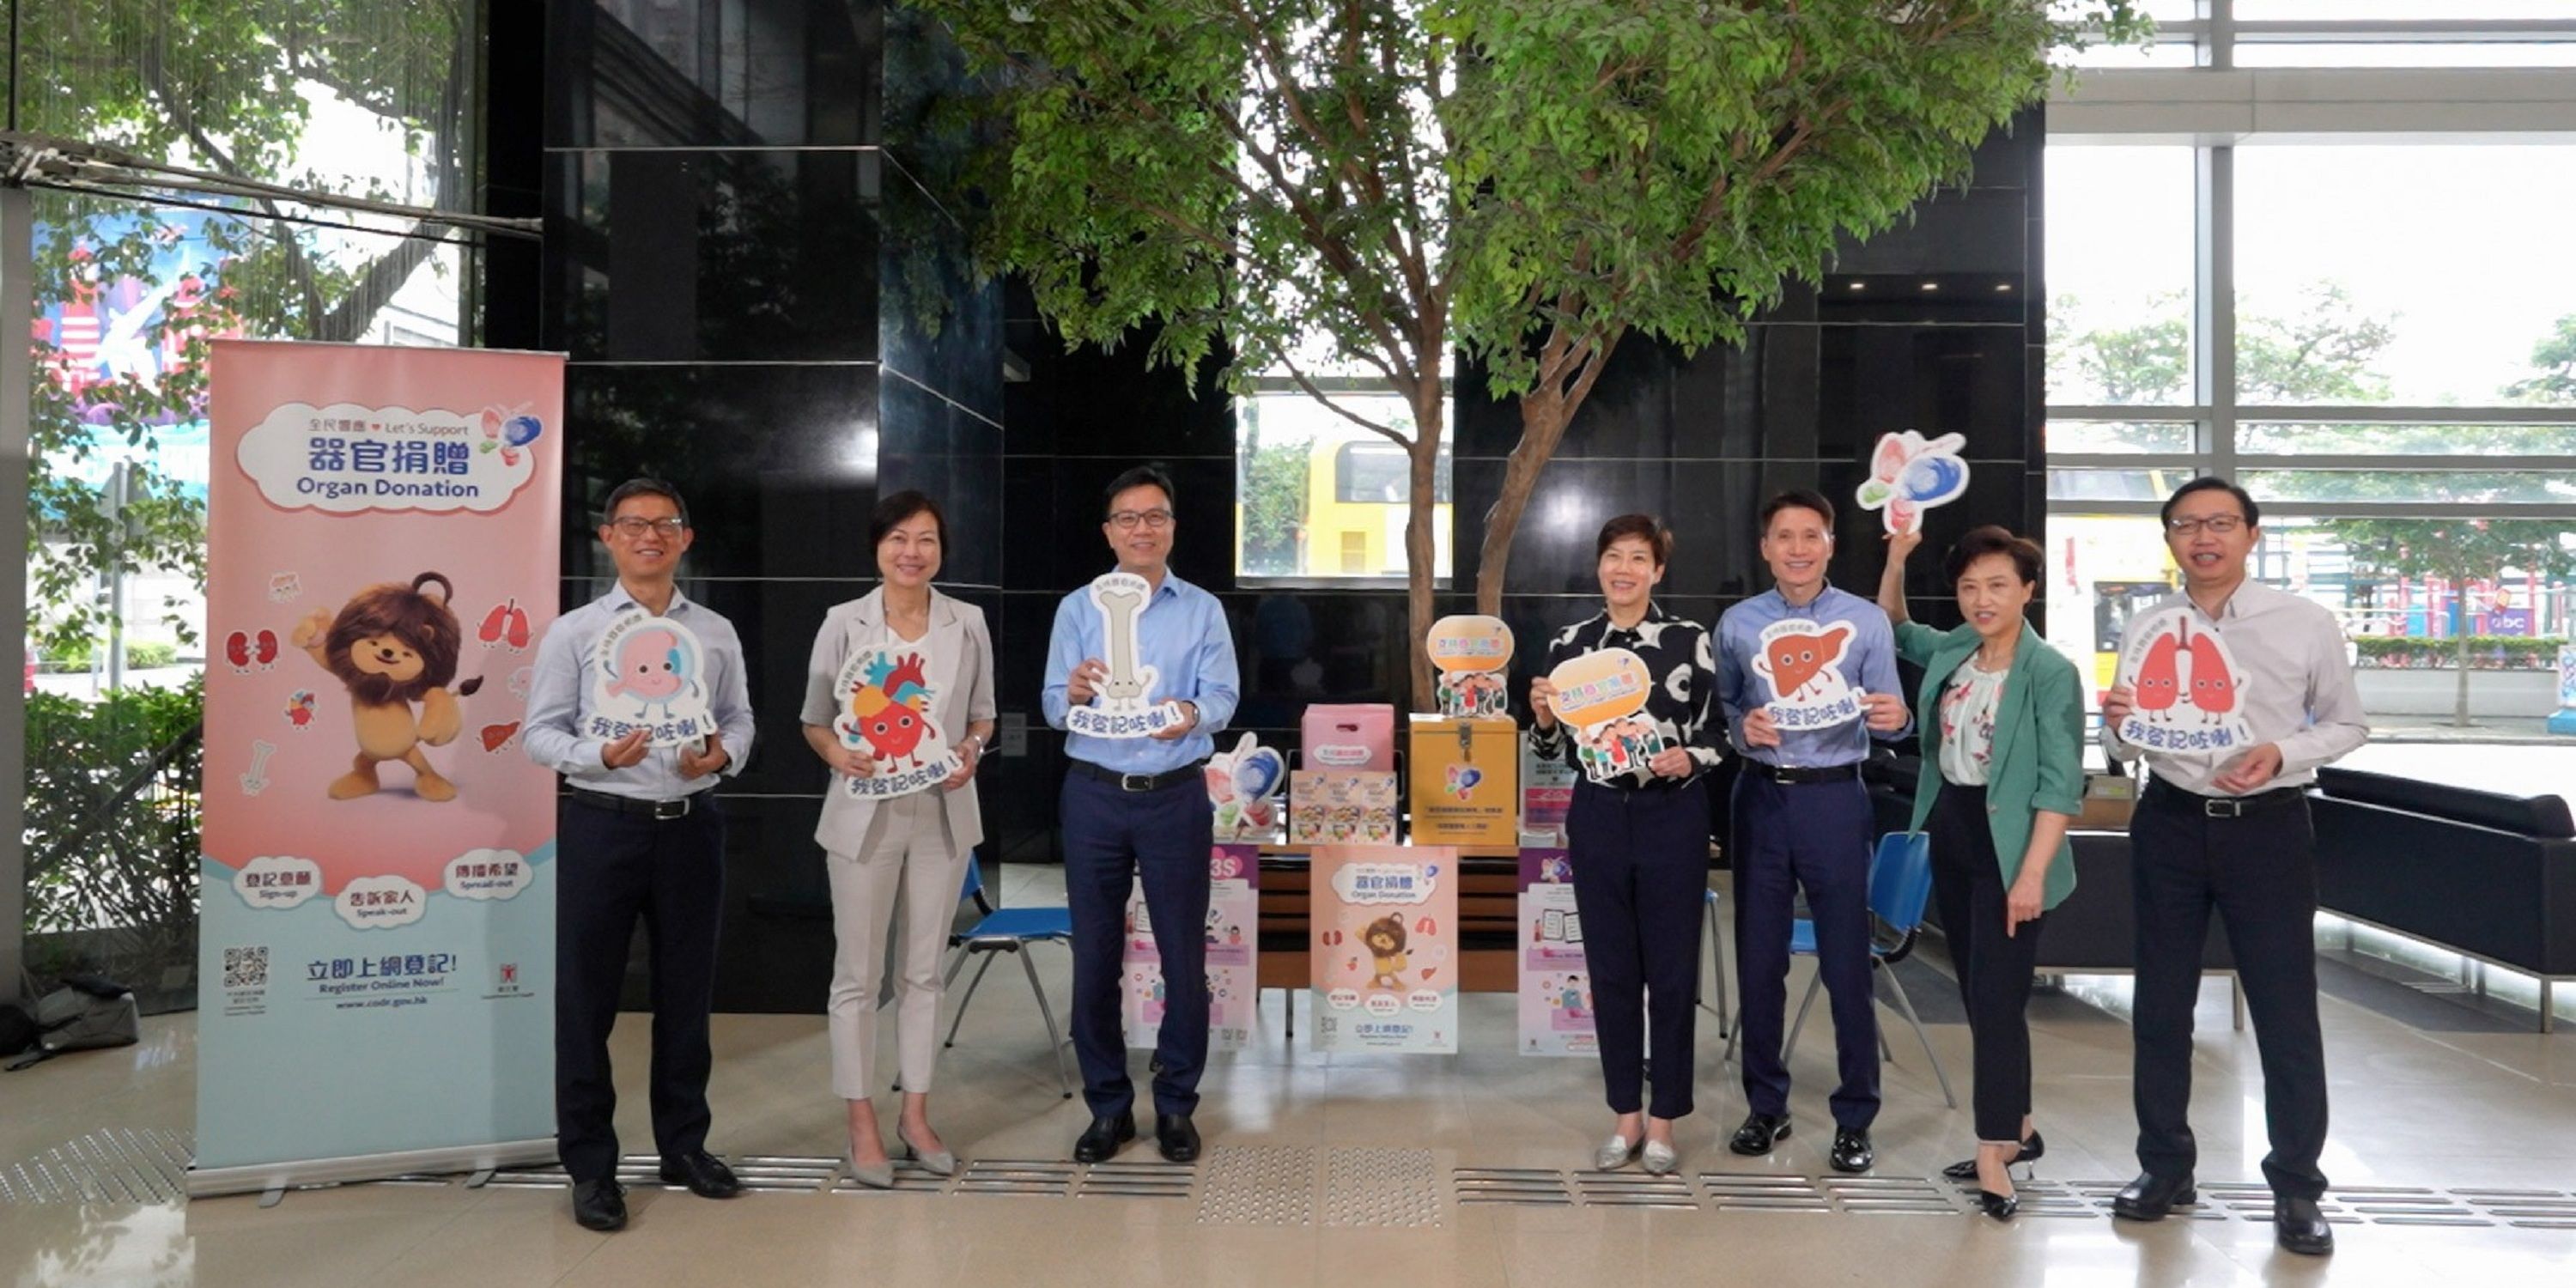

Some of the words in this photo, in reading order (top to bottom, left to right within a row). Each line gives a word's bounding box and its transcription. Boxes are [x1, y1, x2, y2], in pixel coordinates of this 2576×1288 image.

[308, 418, 366, 432] 全民響應
[386, 422, 415, 434] Let's
[417, 422, 469, 437] Support
[308, 437, 469, 475] 器官捐贈
[297, 477, 368, 499] Organ
[375, 478, 479, 498] Donation
[307, 953, 457, 981] 立即上網登記!
[319, 981, 368, 995] Register
[371, 979, 410, 991] Online
